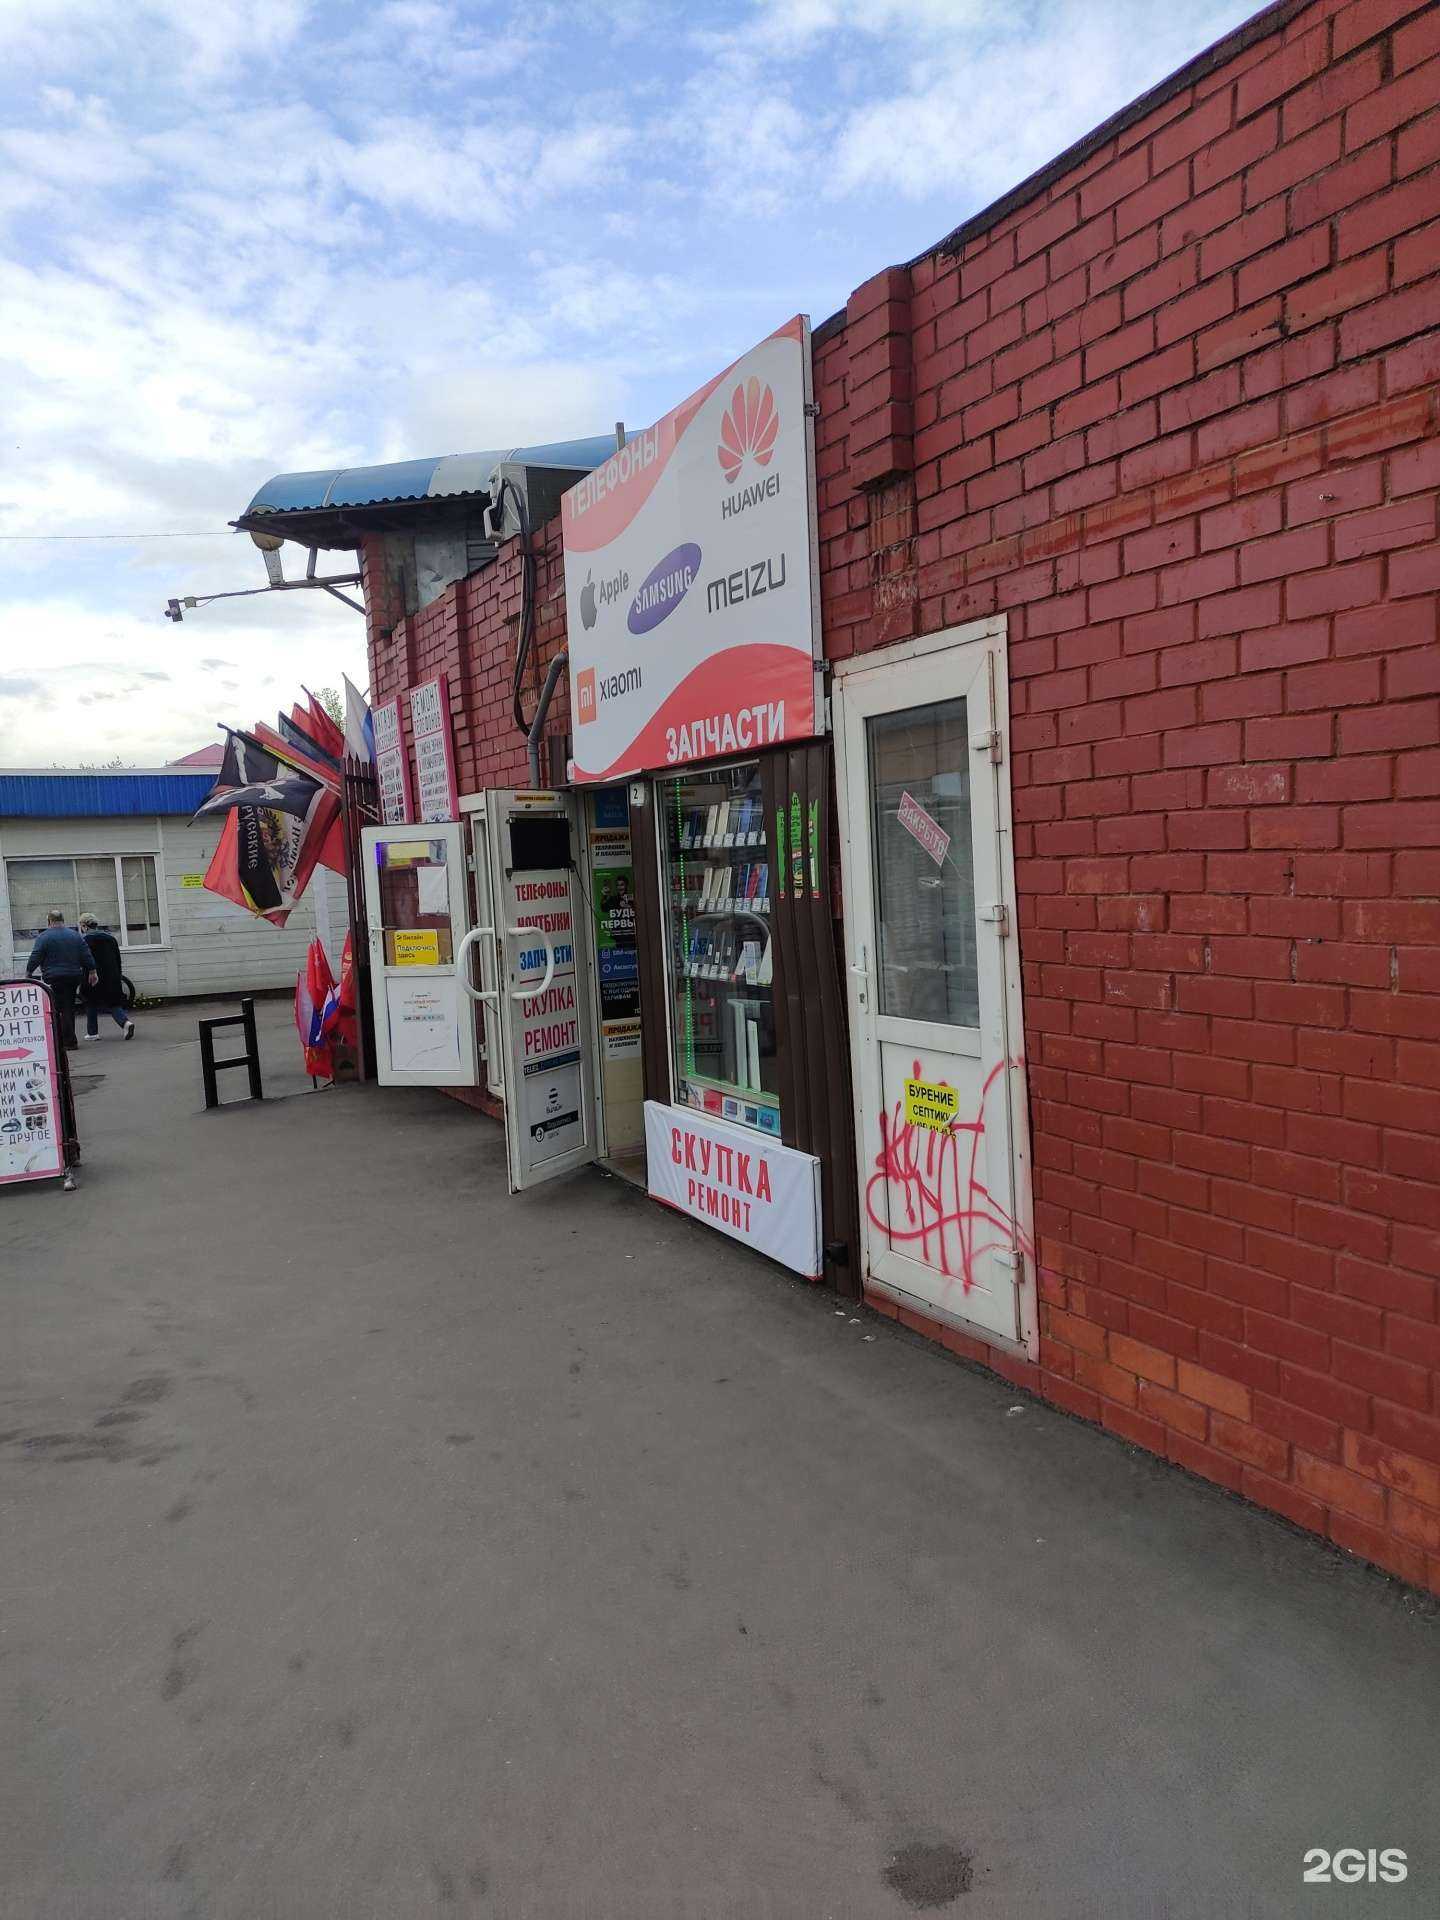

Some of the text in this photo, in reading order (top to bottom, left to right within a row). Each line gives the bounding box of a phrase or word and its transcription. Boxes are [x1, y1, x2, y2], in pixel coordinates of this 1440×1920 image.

[569, 425, 659, 519] ТЕЛЕФОНЫ
[722, 473, 780, 520] HUAWEI
[600, 570, 630, 605] Apple
[635, 565, 693, 615] SAMSUNG
[707, 553, 786, 613] MEIZU
[666, 700, 785, 763] ЗАПЧАСТИ
[633, 788, 639, 799] 2
[901, 802, 945, 857] ЗАКРЫТО
[515, 881, 568, 902] ТЕЛЕФОНЫ
[517, 912, 571, 933] НОУТБУКИ
[610, 908, 636, 918] БУДЬ
[520, 944, 572, 971] ЗАПЧСТИ
[0, 1005, 40, 1018] АРОВ
[523, 986, 575, 1019] СКУПКА
[525, 1020, 576, 1056] РЕМОНТ
[0, 1081, 17, 1092] КИ
[909, 1084, 954, 1107] БУРЕНИЕ
[9, 1129, 51, 1145] ДРУГОЕ
[671, 1127, 772, 1204] СКУПКА
[688, 1178, 751, 1233] РЕМОНТ
